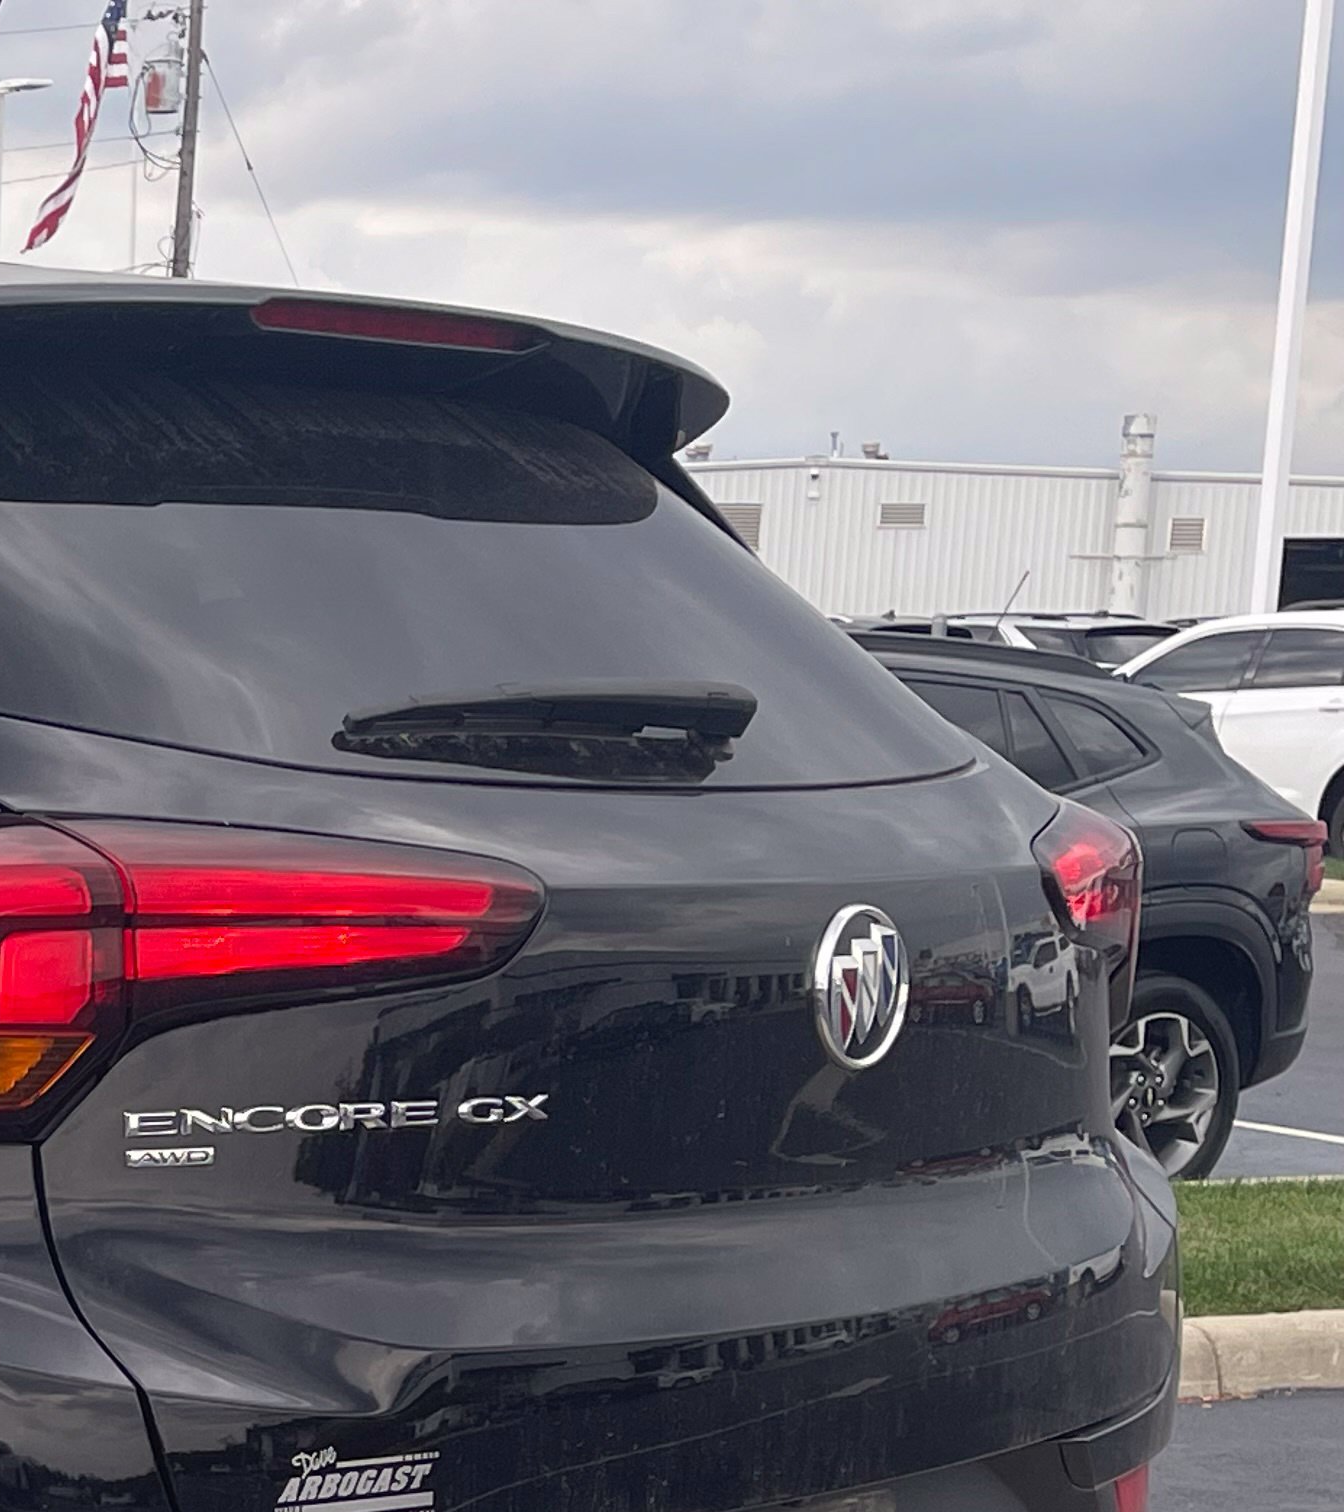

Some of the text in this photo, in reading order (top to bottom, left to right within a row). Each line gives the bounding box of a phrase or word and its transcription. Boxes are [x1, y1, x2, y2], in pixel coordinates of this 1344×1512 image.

[124, 1094, 549, 1137] ENCORE GX
[134, 1149, 213, 1166] AWD
[291, 1446, 337, 1478] Dave
[277, 1463, 433, 1503] ARBOGAST
